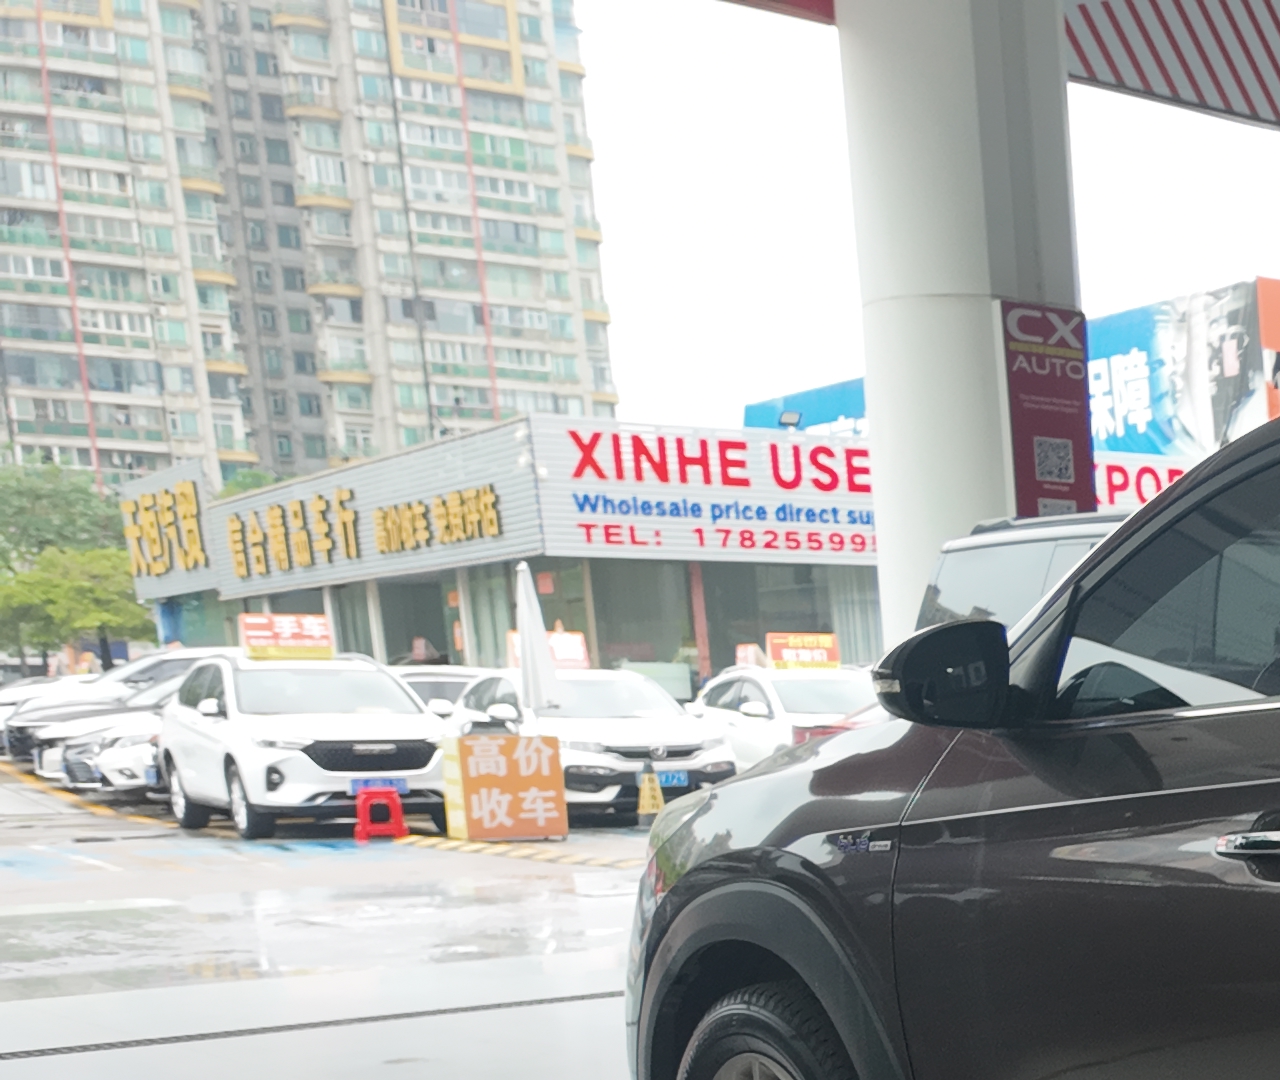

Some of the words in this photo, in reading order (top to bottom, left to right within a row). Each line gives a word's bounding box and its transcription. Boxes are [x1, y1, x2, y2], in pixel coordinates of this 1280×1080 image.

[1006, 308, 1084, 349] CX
[1012, 354, 1085, 380] AUTO
[568, 430, 751, 487] XINHE
[572, 493, 702, 518] Wholesale
[710, 501, 768, 524] price
[774, 503, 840, 524] direct
[847, 509, 875, 530] su
[577, 523, 663, 547] TEL:
[692, 528, 878, 553] 17825599
[244, 616, 331, 639] 二手车
[464, 737, 554, 777] 高价
[471, 787, 560, 829] 收车
